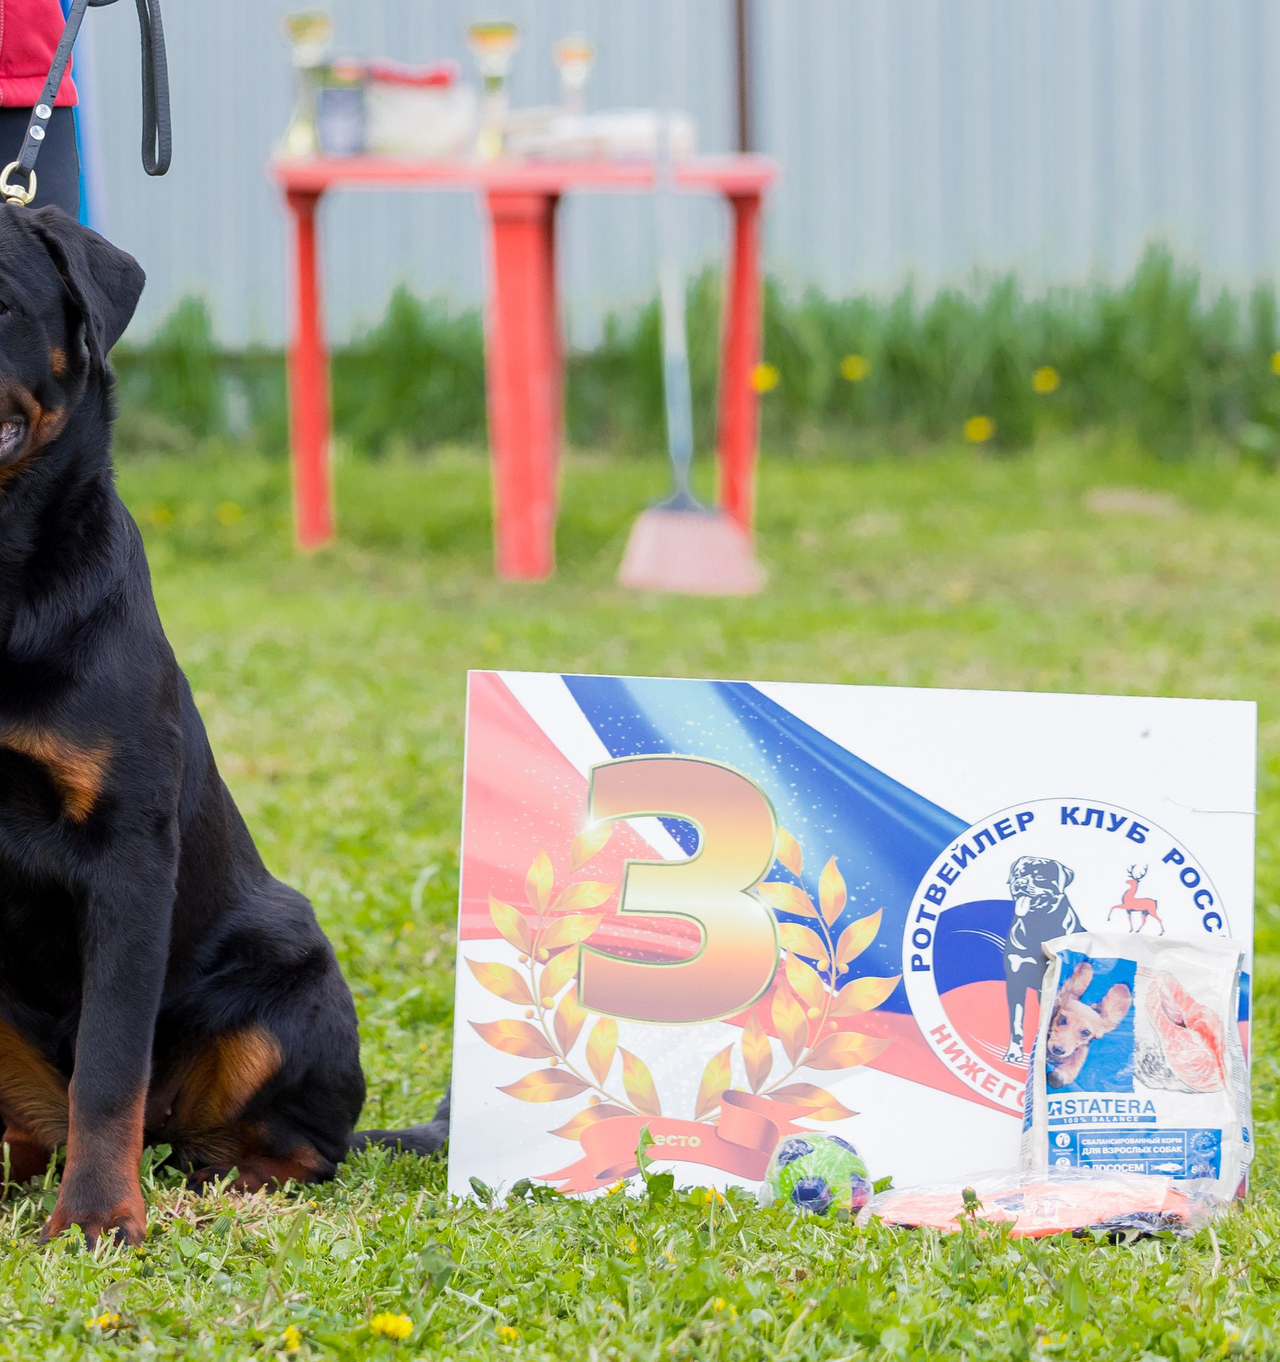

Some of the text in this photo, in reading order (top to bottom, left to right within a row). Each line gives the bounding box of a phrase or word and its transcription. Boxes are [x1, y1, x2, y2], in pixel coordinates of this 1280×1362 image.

[577, 753, 781, 1027] 3
[912, 806, 1223, 972] РОТВЕЙЛЕР КЛУБ РОСС
[1064, 1099, 1156, 1115] STATERA
[652, 1134, 701, 1148] есто
[1081, 1137, 1160, 1146] СБАЛАНСИРОВАННЫЙ
[1081, 1147, 1100, 1155] ДЛЯ
[1102, 1146, 1152, 1154] ВЗРОСЛЫХ
